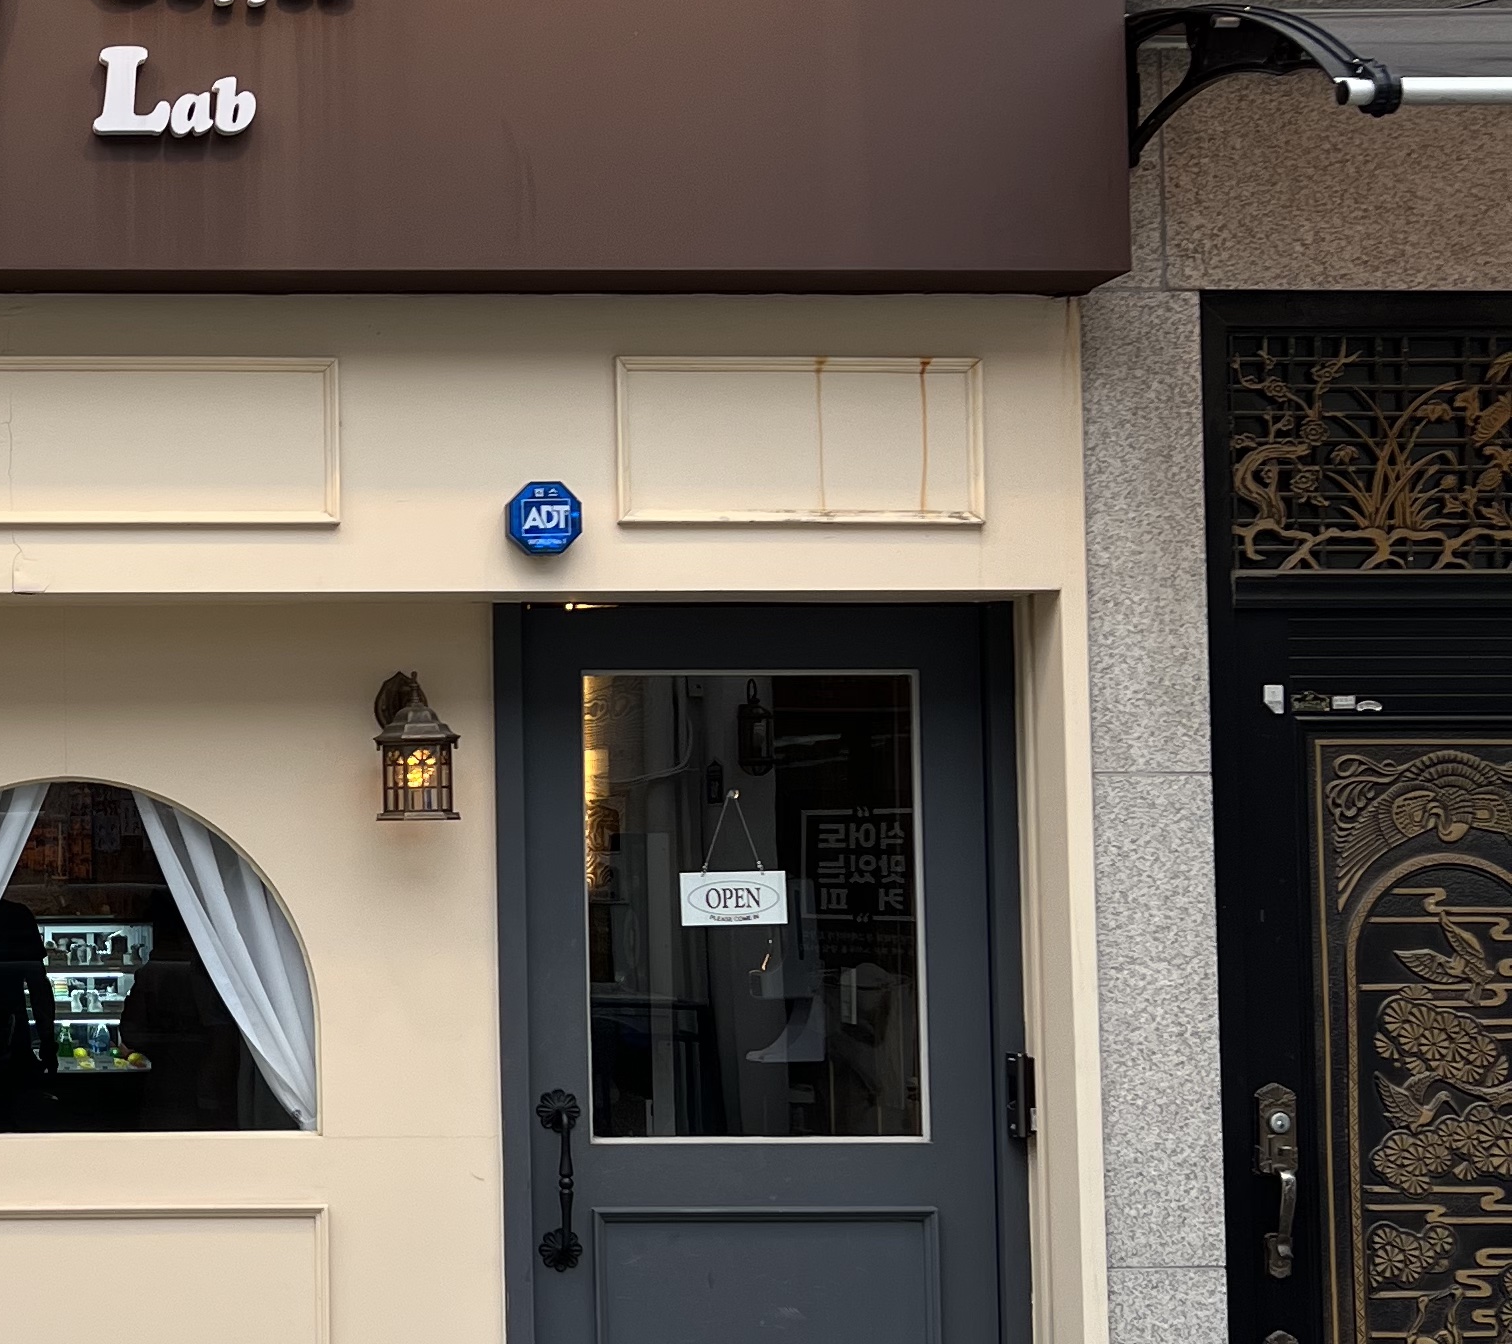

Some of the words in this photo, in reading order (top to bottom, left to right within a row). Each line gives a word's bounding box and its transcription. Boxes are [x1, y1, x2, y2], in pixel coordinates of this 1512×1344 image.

[92, 45, 257, 138] Lab
[521, 504, 571, 530] ADT
[705, 887, 761, 909] OPEN
[733, 914, 752, 922] COME
